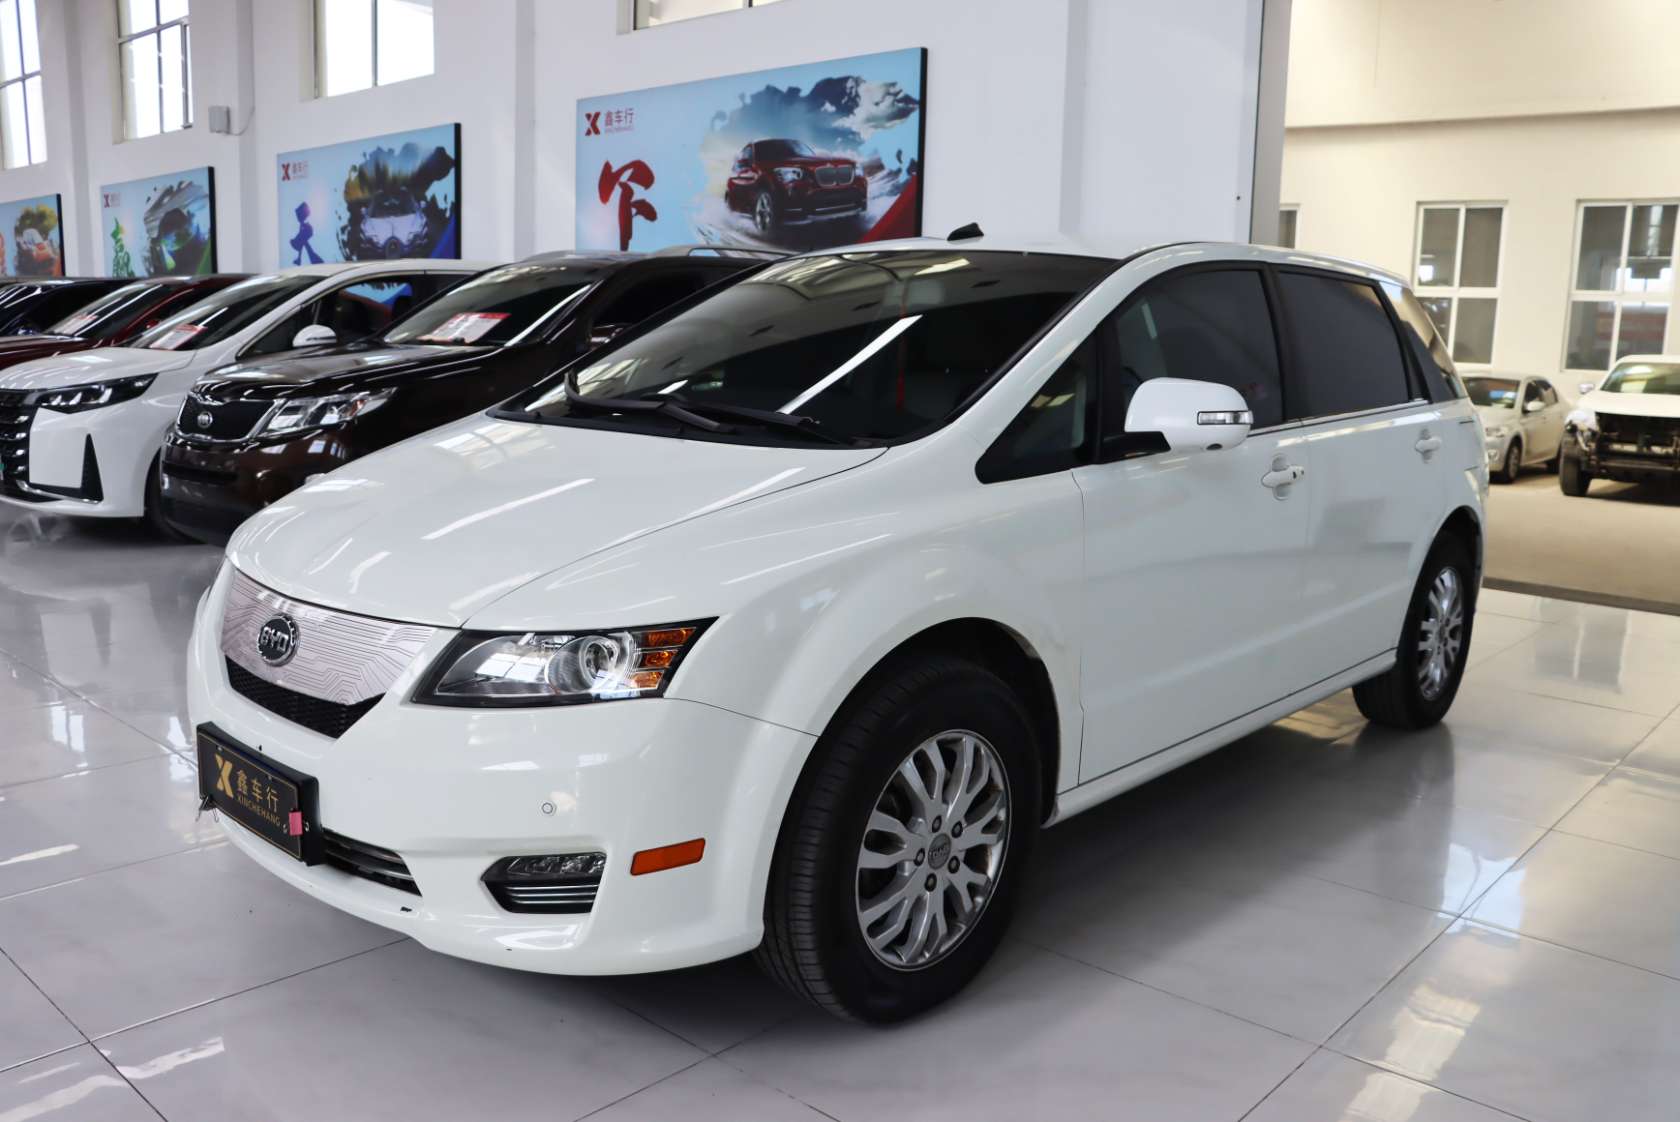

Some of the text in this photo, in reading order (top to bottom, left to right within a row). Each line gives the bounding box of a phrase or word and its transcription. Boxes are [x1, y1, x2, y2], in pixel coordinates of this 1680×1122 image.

[261, 626, 289, 652] BYD
[237, 769, 279, 813] 鑫车行
[238, 795, 281, 827] XINCHEHANG
